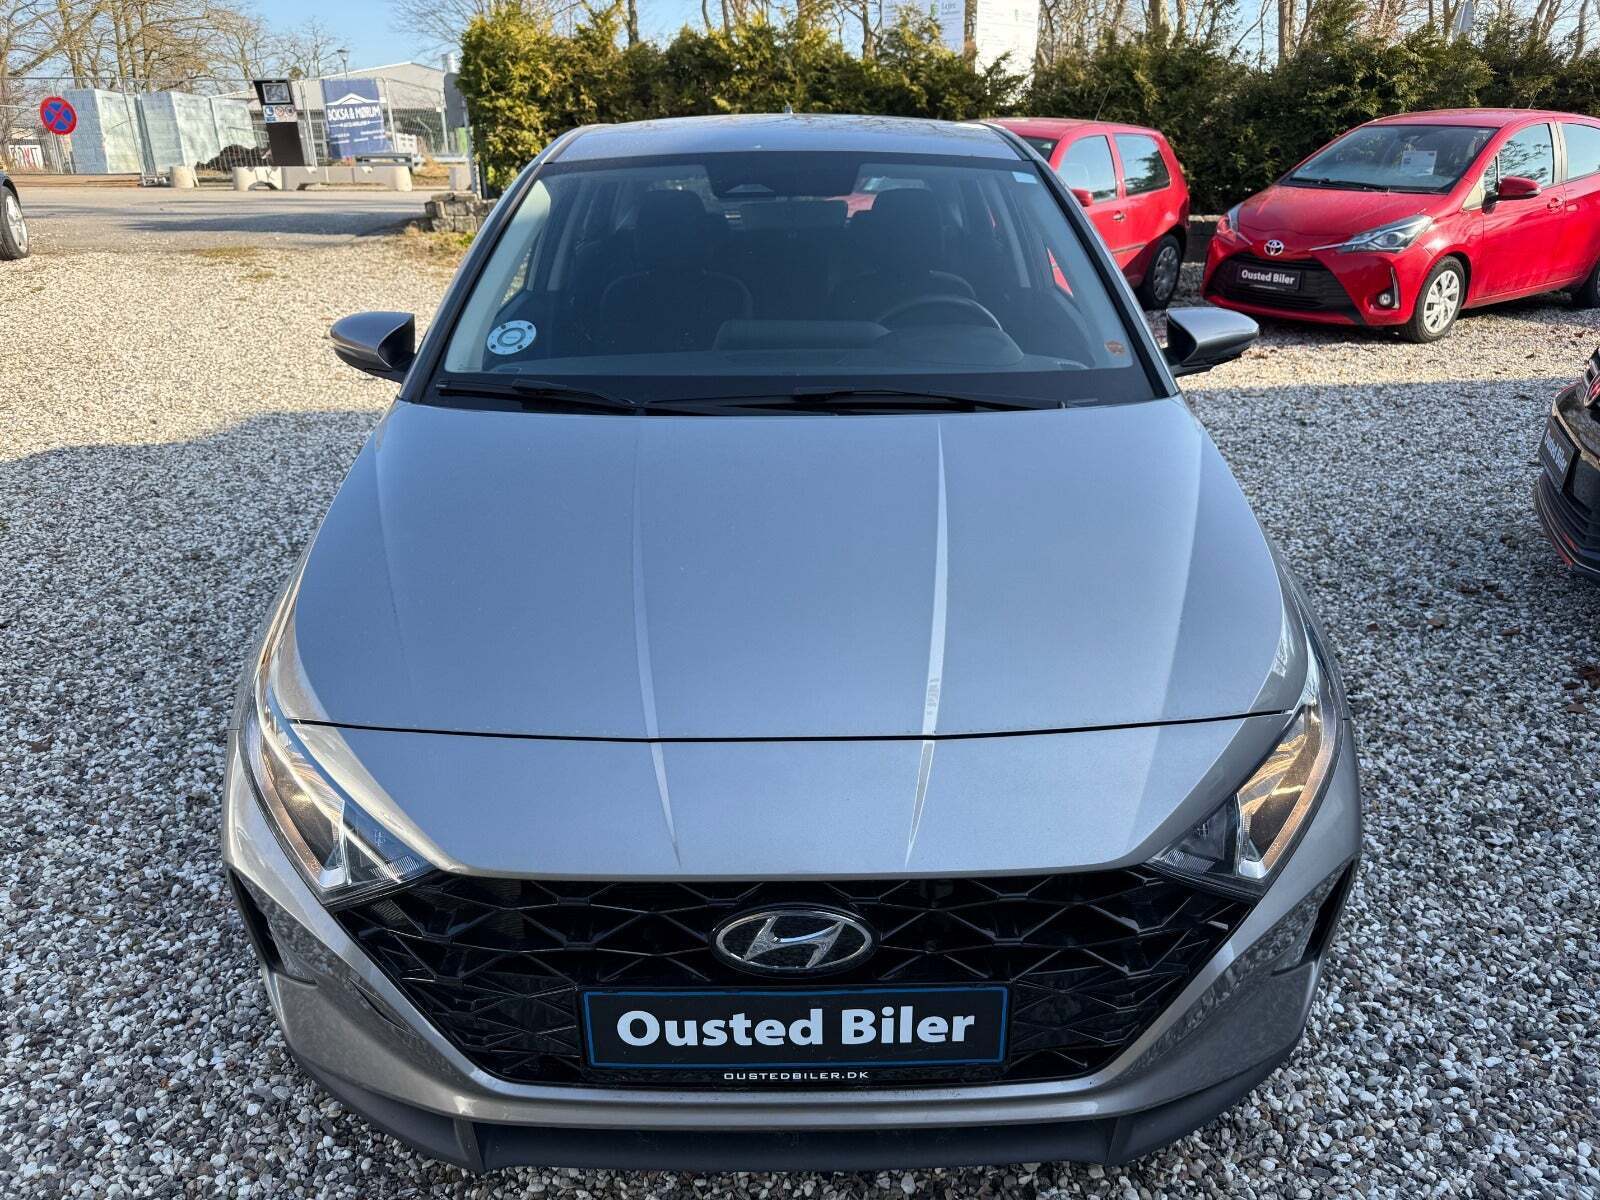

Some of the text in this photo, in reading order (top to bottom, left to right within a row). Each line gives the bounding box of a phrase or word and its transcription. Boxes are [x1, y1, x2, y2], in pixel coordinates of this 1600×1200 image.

[1241, 269, 1295, 285] Ousted Biler
[616, 1005, 975, 1046] Ousted Biler
[723, 1071, 869, 1080] OUSTEDBILER.DK
